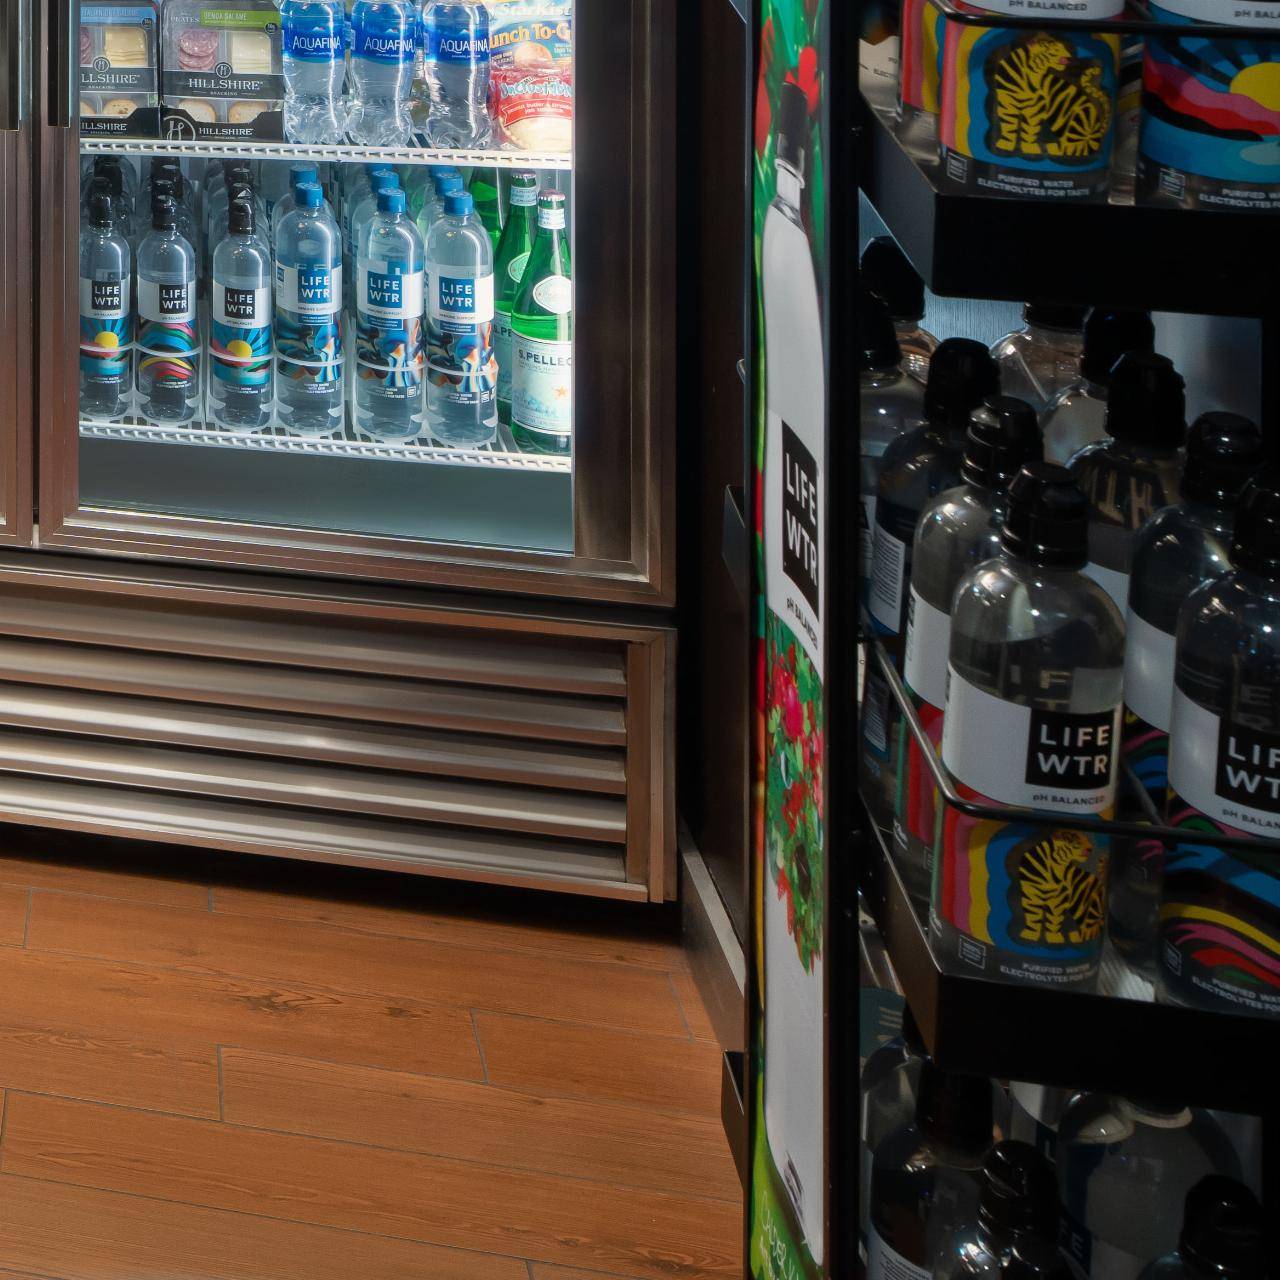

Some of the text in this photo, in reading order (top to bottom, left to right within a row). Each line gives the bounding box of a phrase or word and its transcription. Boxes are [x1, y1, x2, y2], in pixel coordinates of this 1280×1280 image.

[1008, 0, 1088, 12] pH BALANCED
[292, 35, 342, 51] AQUAFINA
[364, 37, 415, 53] AQUAFINA
[440, 37, 490, 53] AQUAFINA
[188, 78, 261, 91] HILLSHIRE
[198, 127, 253, 136] HILLSHIRE
[977, 177, 1066, 198] ELECTROLYTES FOR
[997, 173, 1075, 189] PURIFIED WATER
[1221, 188, 1266, 200] PURIFIED
[1198, 193, 1271, 209] ELECTROLYTES
[300, 275, 329, 287] LIFE
[369, 278, 400, 290] LIFE
[94, 285, 121, 296] LIFE
[161, 288, 187, 299] LIFE
[300, 287, 330, 299] WTR
[442, 283, 473, 295] LIFE
[94, 296, 121, 307] WTR
[226, 292, 253, 303] LIFE
[369, 290, 401, 303] WTR
[441, 295, 474, 308] WTR
[161, 299, 188, 310] WTR
[226, 304, 254, 315] WTR
[785, 452, 817, 526] LIFE
[785, 508, 818, 587] WTR
[1040, 723, 1111, 748] LIFE
[1036, 751, 1108, 776] WTR
[1032, 793, 1105, 806] pH BALANCED
[999, 965, 1069, 983] ELECTROLYTES
[1022, 962, 1063, 974] PURIFIED
